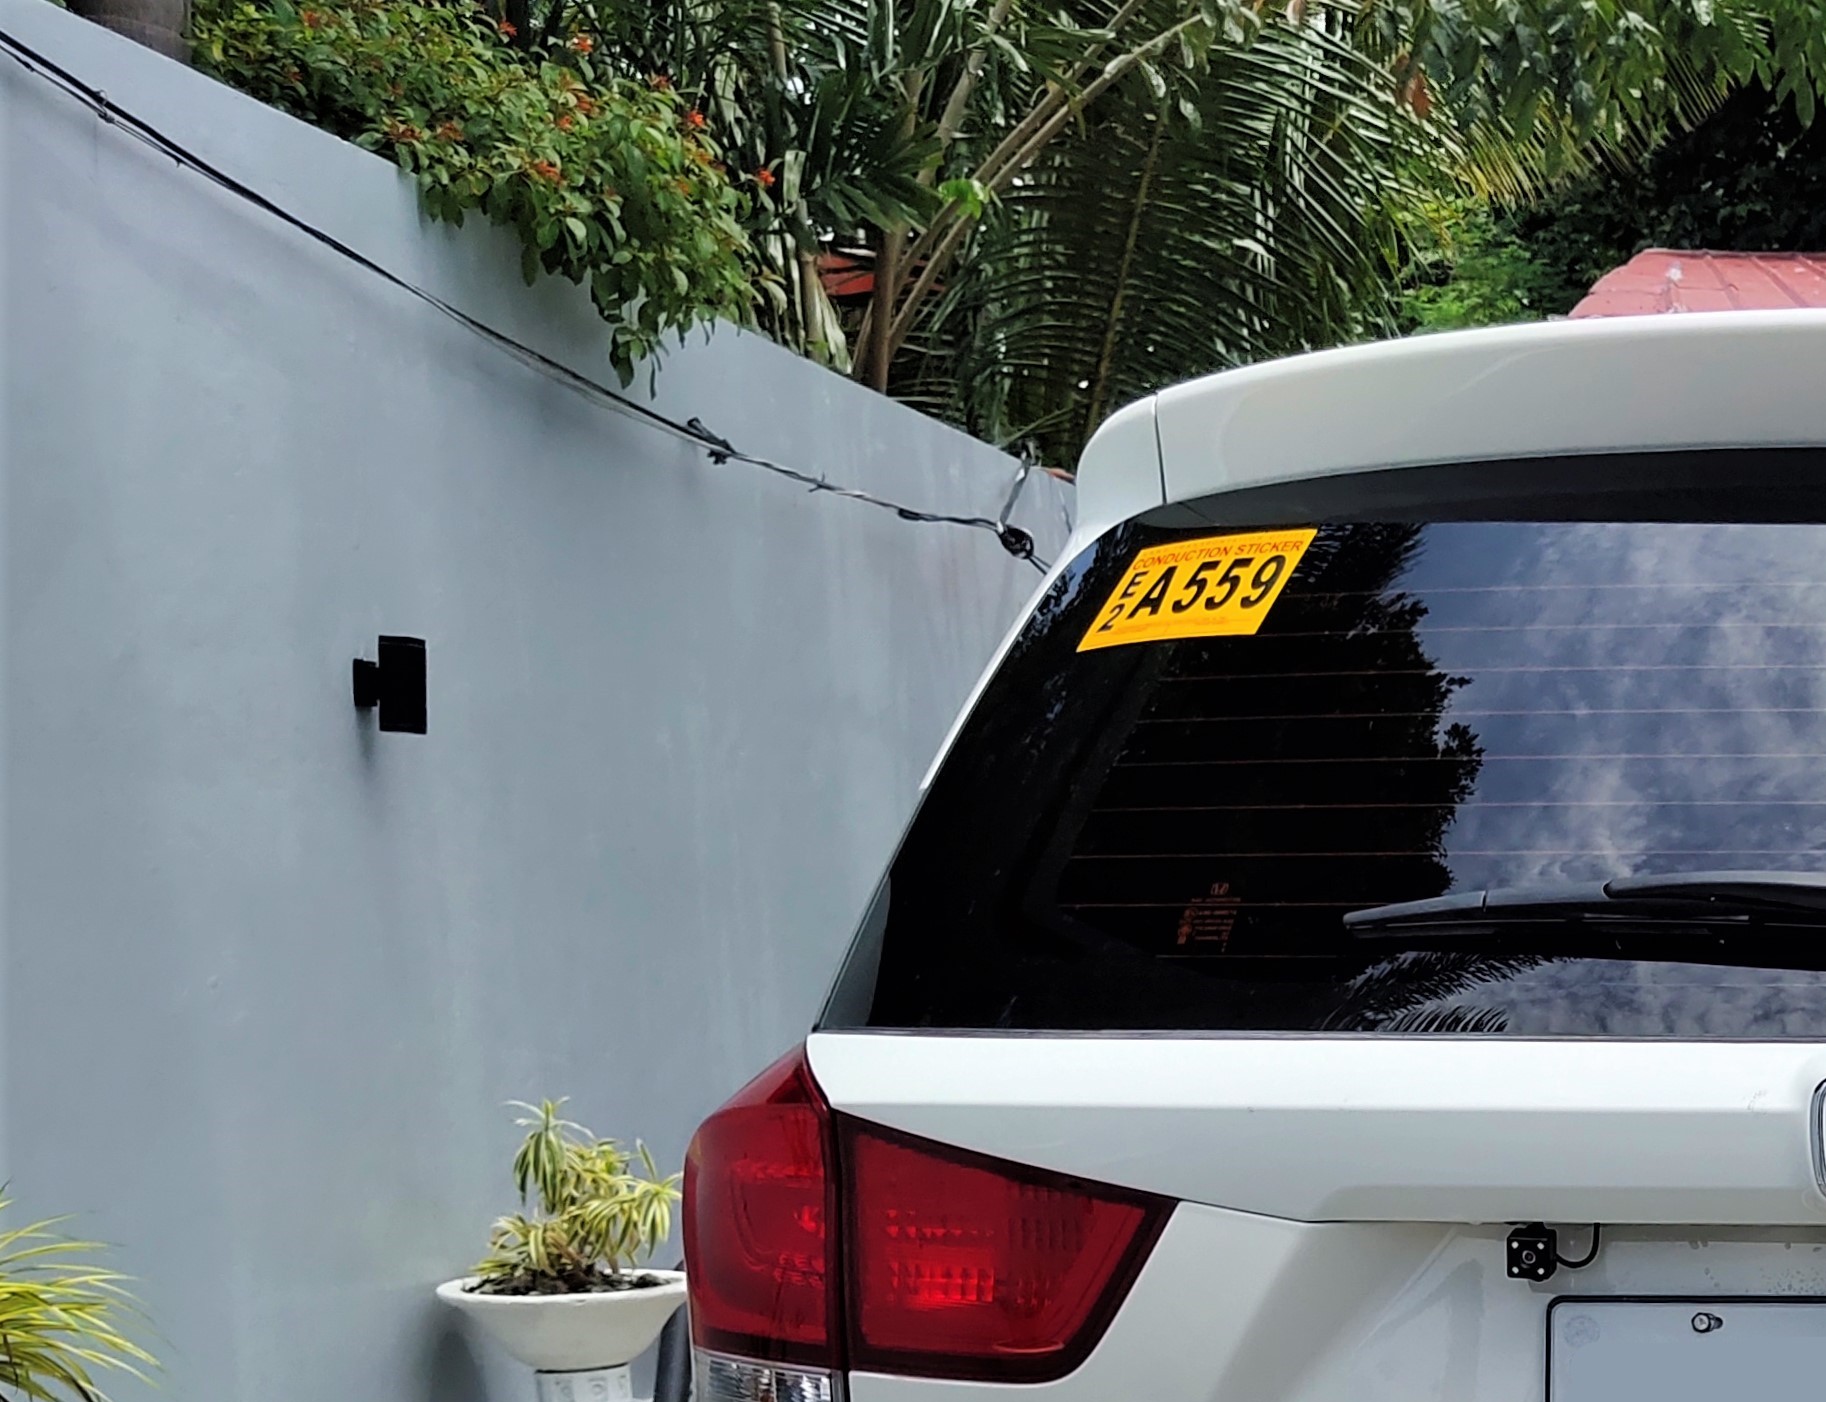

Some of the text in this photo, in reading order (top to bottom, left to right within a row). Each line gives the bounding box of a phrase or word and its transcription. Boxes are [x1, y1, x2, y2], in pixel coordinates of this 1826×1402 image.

[1132, 546, 1232, 571] CONDUCTION
[1234, 540, 1304, 556] STICKER
[1126, 554, 1287, 620] A559
